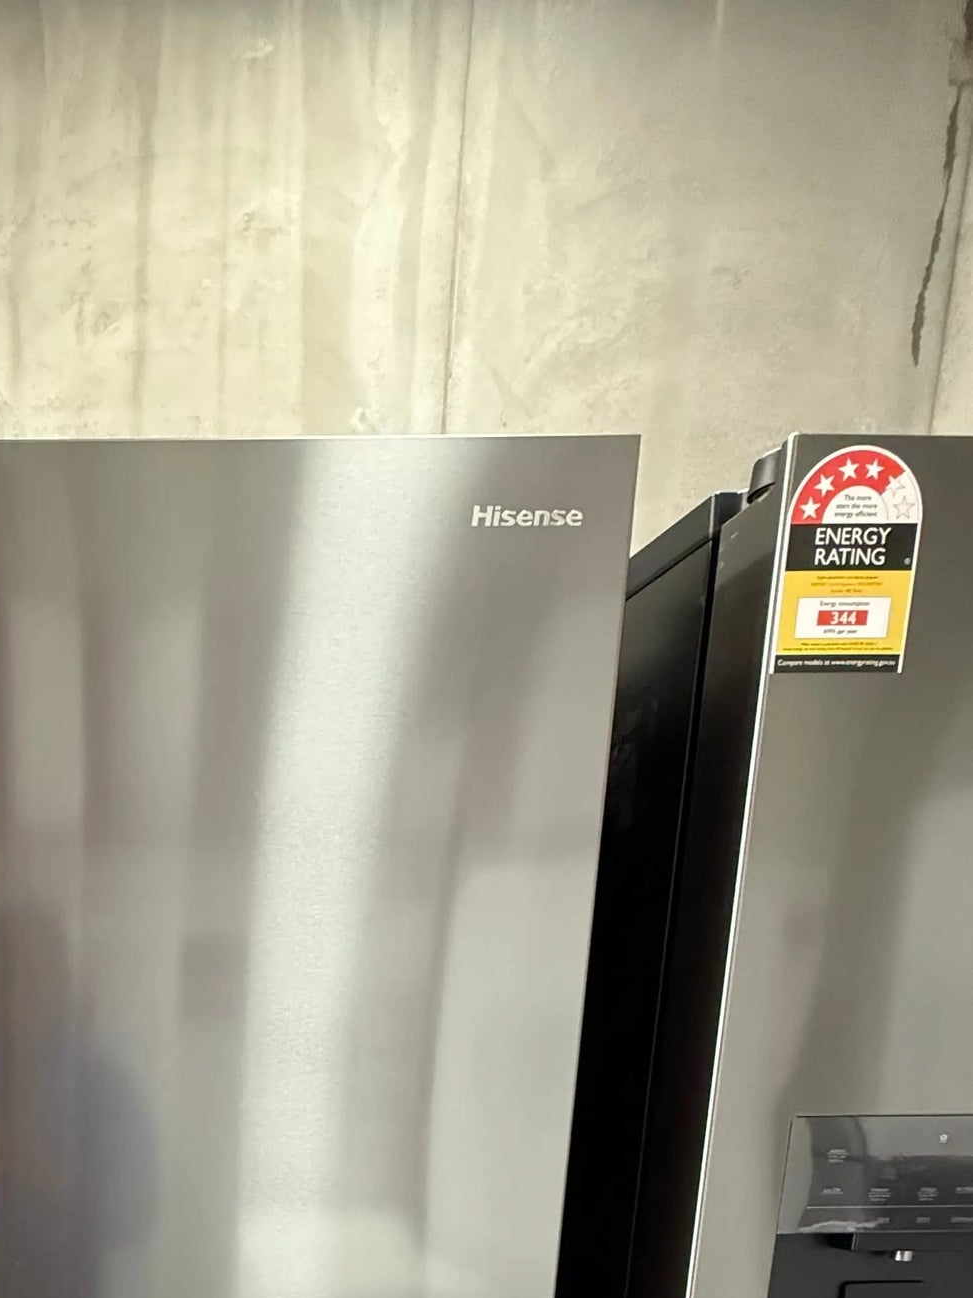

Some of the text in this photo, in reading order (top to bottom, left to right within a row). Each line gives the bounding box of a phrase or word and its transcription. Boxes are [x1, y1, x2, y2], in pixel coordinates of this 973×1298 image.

[471, 505, 583, 527] Hisense
[815, 527, 892, 545] ENERGY
[814, 548, 886, 566] RATING
[830, 611, 857, 625] 344
